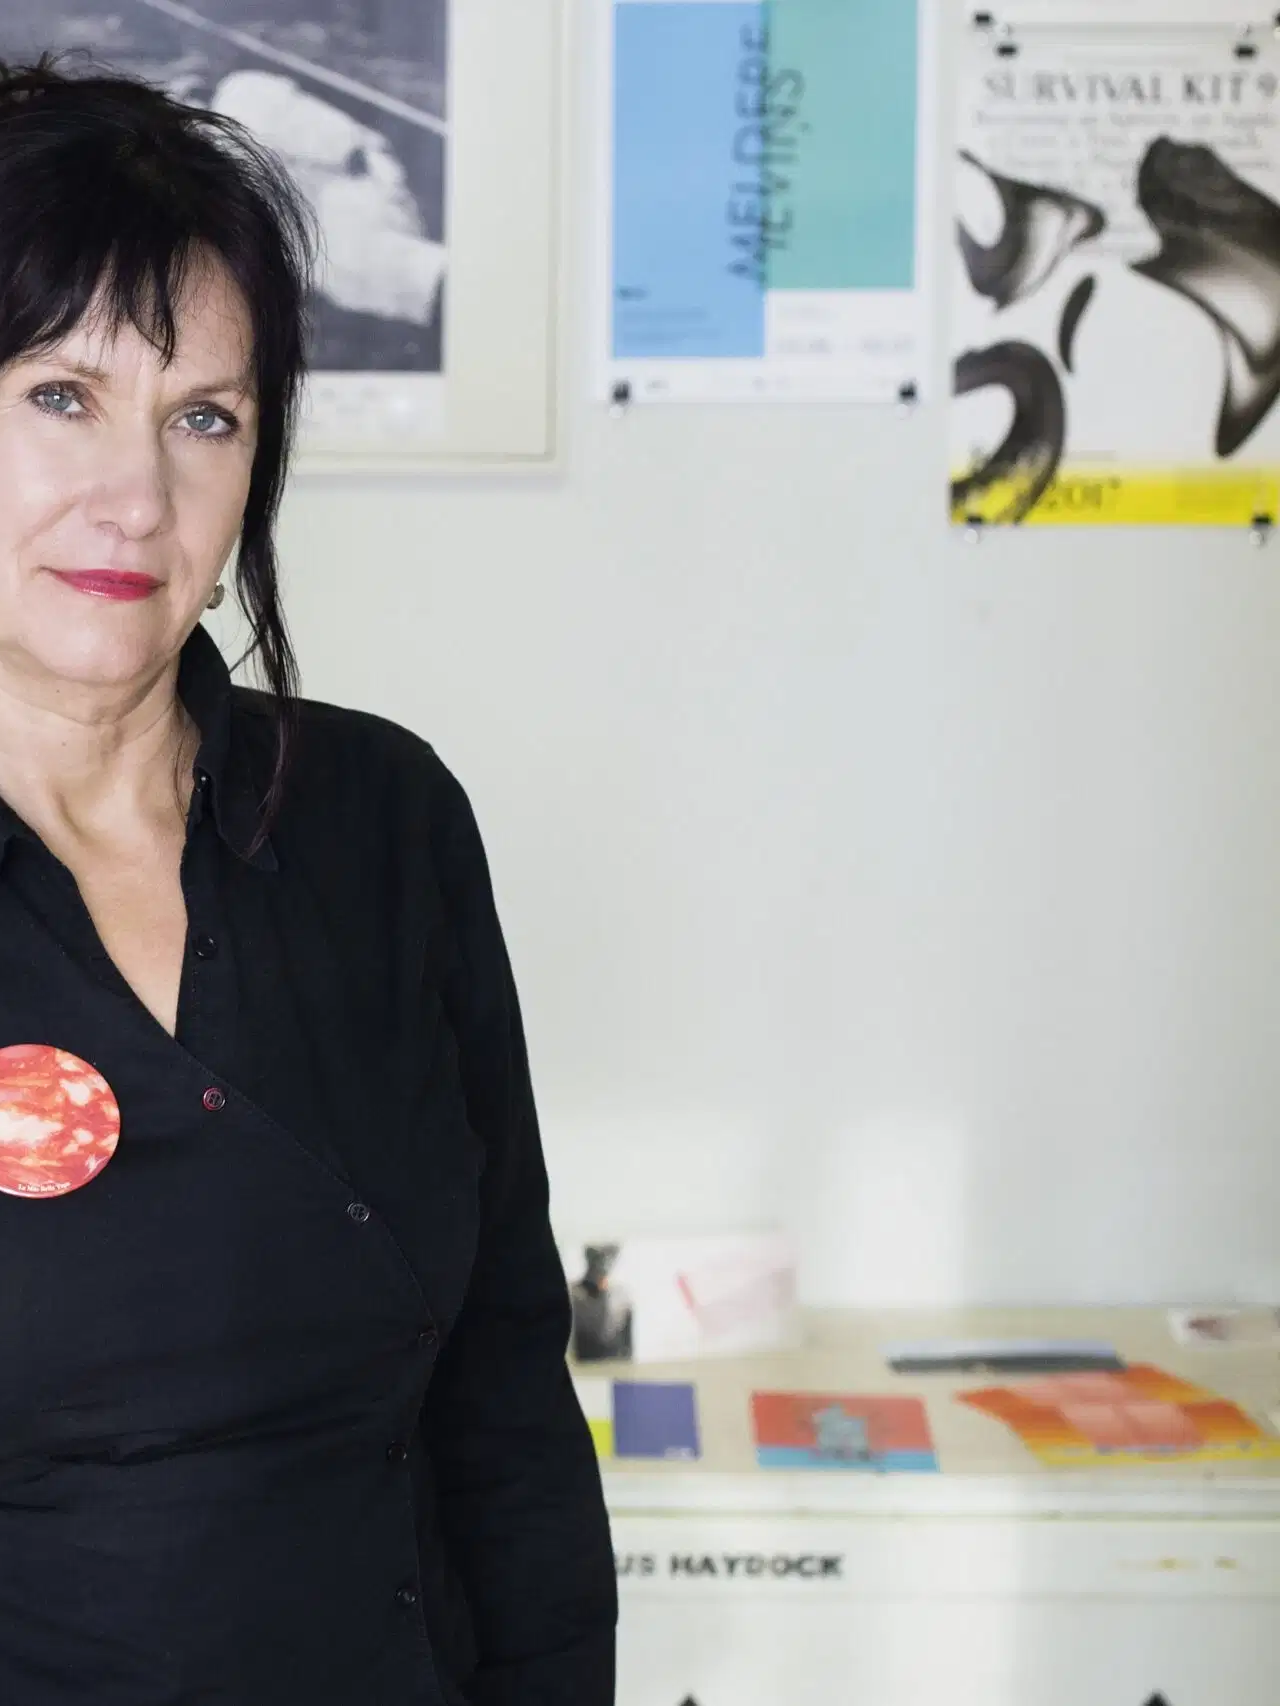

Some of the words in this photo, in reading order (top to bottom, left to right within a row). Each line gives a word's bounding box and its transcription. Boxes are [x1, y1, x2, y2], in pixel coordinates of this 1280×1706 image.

[983, 71, 1171, 104] SURVIVAL
[1181, 71, 1249, 104] KIT
[670, 1554, 844, 1578] HAYDOCK
